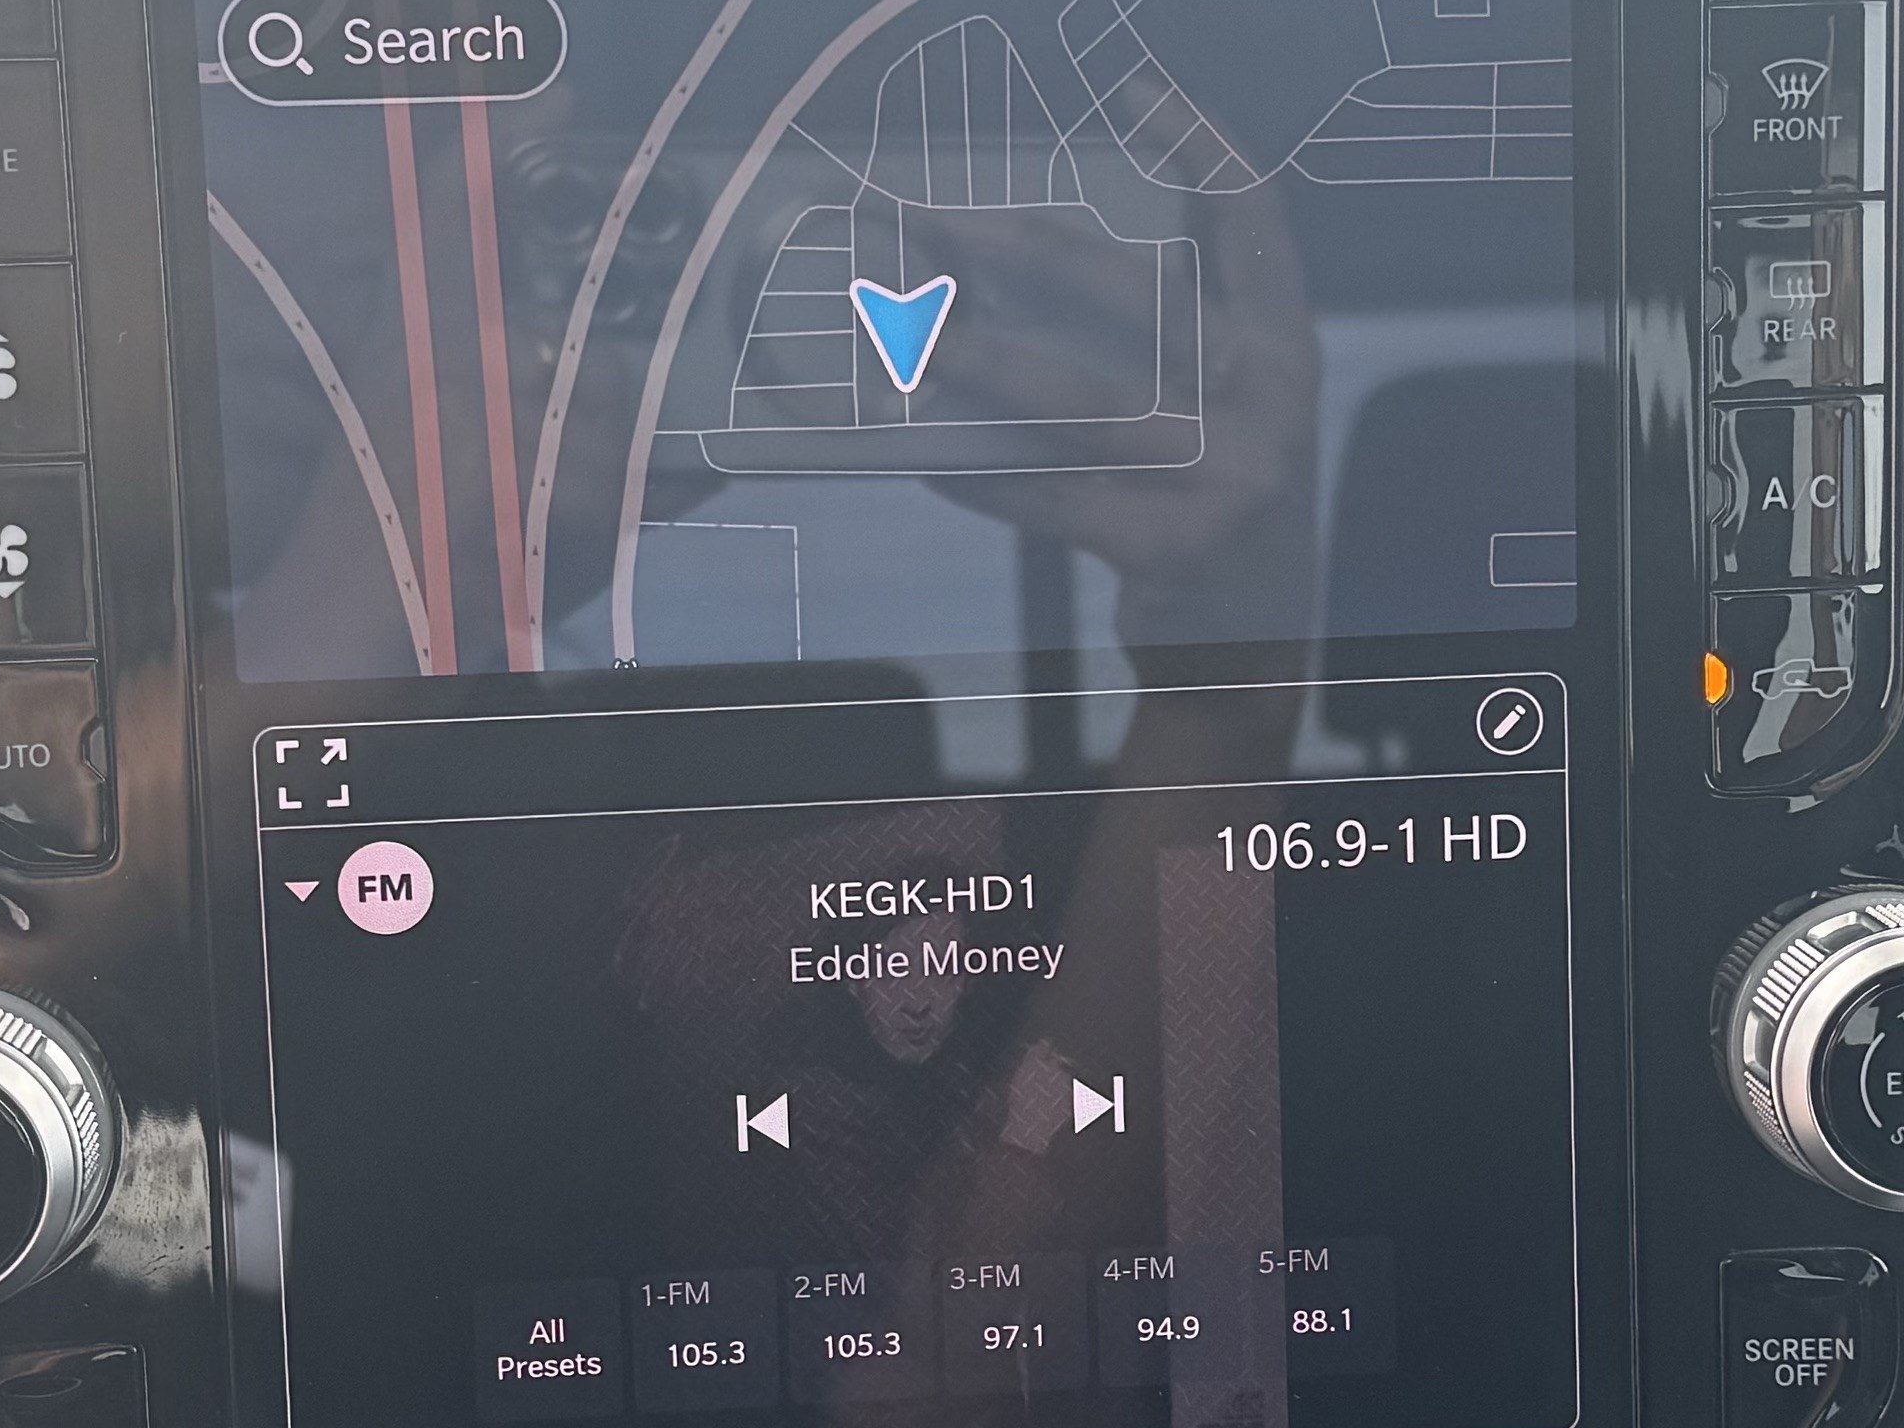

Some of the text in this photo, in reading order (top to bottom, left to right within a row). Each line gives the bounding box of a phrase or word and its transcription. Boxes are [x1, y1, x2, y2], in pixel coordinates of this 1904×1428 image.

[343, 14, 525, 66] Search
[1753, 116, 1843, 142] FRONT
[1763, 318, 1838, 343] REAR
[1761, 474, 1838, 511] A/C
[1216, 814, 1528, 874] 106.9-1 HD
[357, 874, 412, 902] FM
[810, 874, 1037, 919] KEGK-HD1
[789, 938, 1065, 984] Eddie Money
[1103, 1256, 1175, 1282] 4-FM
[1258, 1248, 1329, 1274] 5-FM
[794, 1273, 867, 1299] 2-FM
[949, 1264, 1021, 1291] 3-FM
[641, 1281, 710, 1307] 1-FM
[529, 1319, 566, 1346] All
[1137, 1315, 1201, 1343] 94.9
[1292, 1307, 1353, 1335] 88.1
[823, 1331, 902, 1360] 105.3
[983, 1323, 1045, 1351] 97.1
[1745, 1338, 1854, 1361] SCREEN
[497, 1351, 602, 1381] Presets
[667, 1340, 746, 1369] 105.3
[1775, 1363, 1827, 1387] OFF
